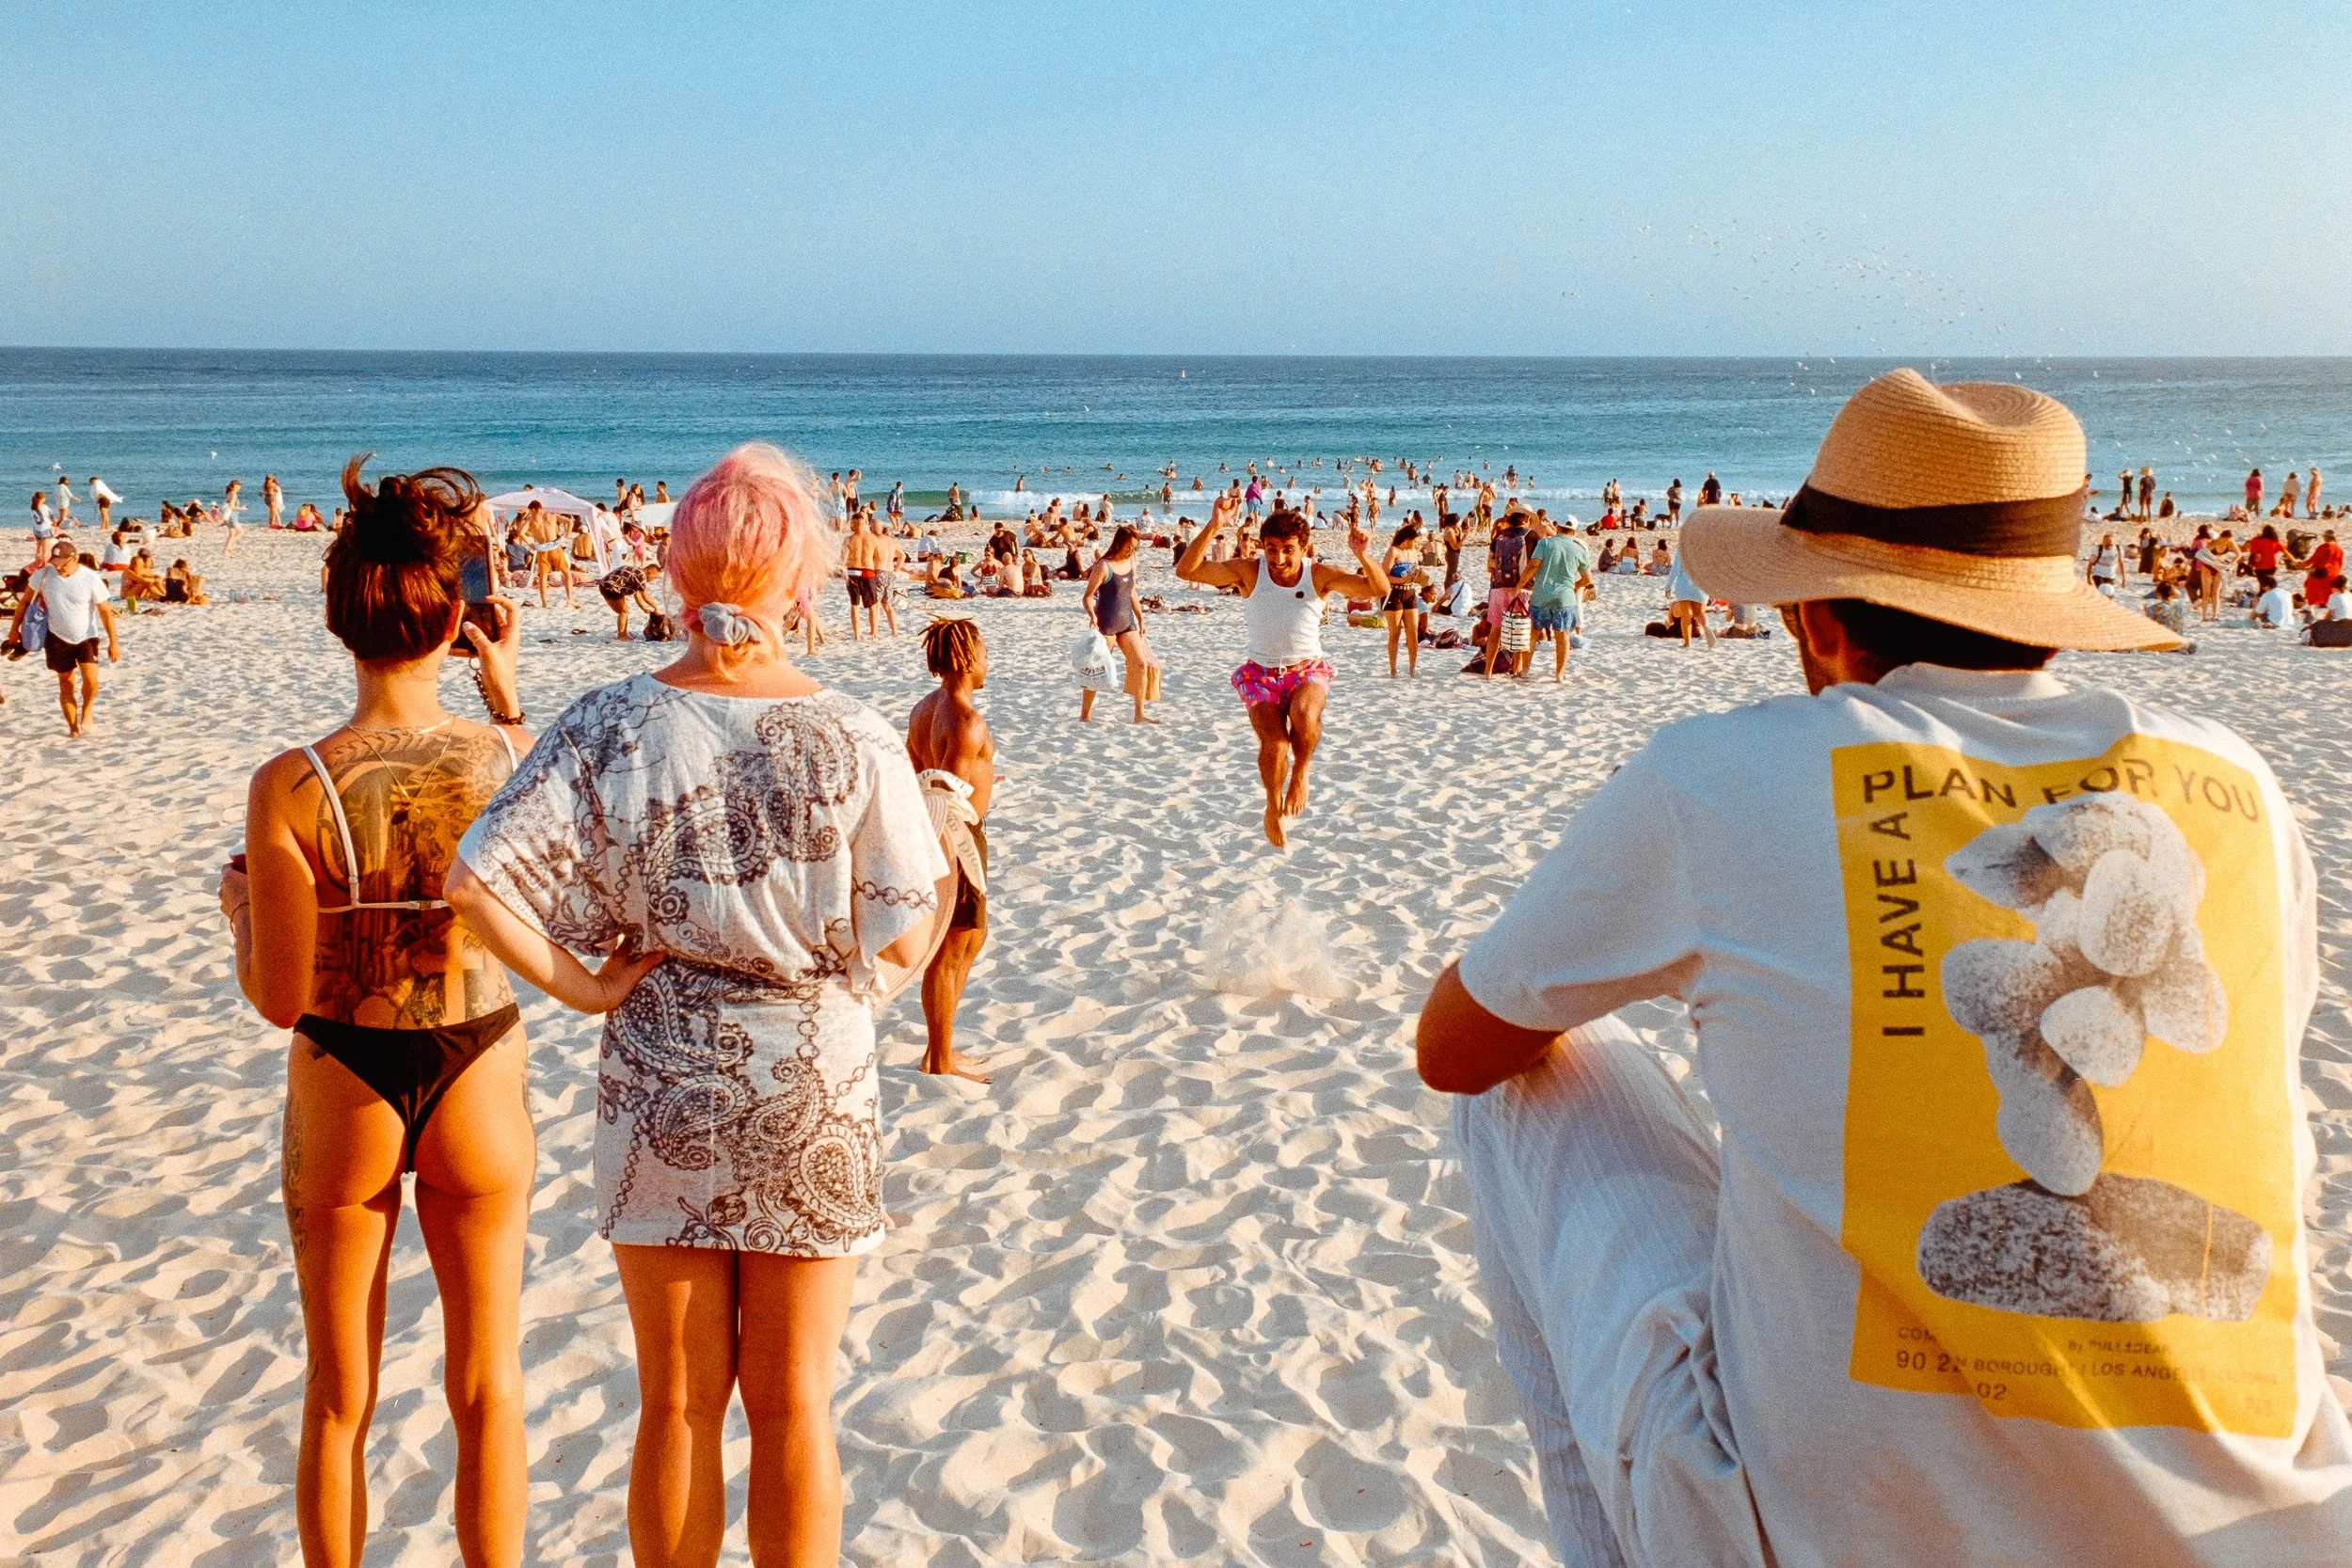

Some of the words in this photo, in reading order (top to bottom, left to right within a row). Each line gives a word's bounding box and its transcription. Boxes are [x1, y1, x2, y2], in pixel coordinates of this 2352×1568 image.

[1863, 764, 2017, 808] PLAN
[2042, 757, 2158, 804] FOR
[2174, 764, 2260, 822] YOU
[1869, 812, 1912, 841] A
[1872, 858, 1925, 998] HAVE
[1883, 1026, 1925, 1037] I
[1896, 1350, 1927, 1370] 90
[2091, 1363, 2125, 1378] LOS
